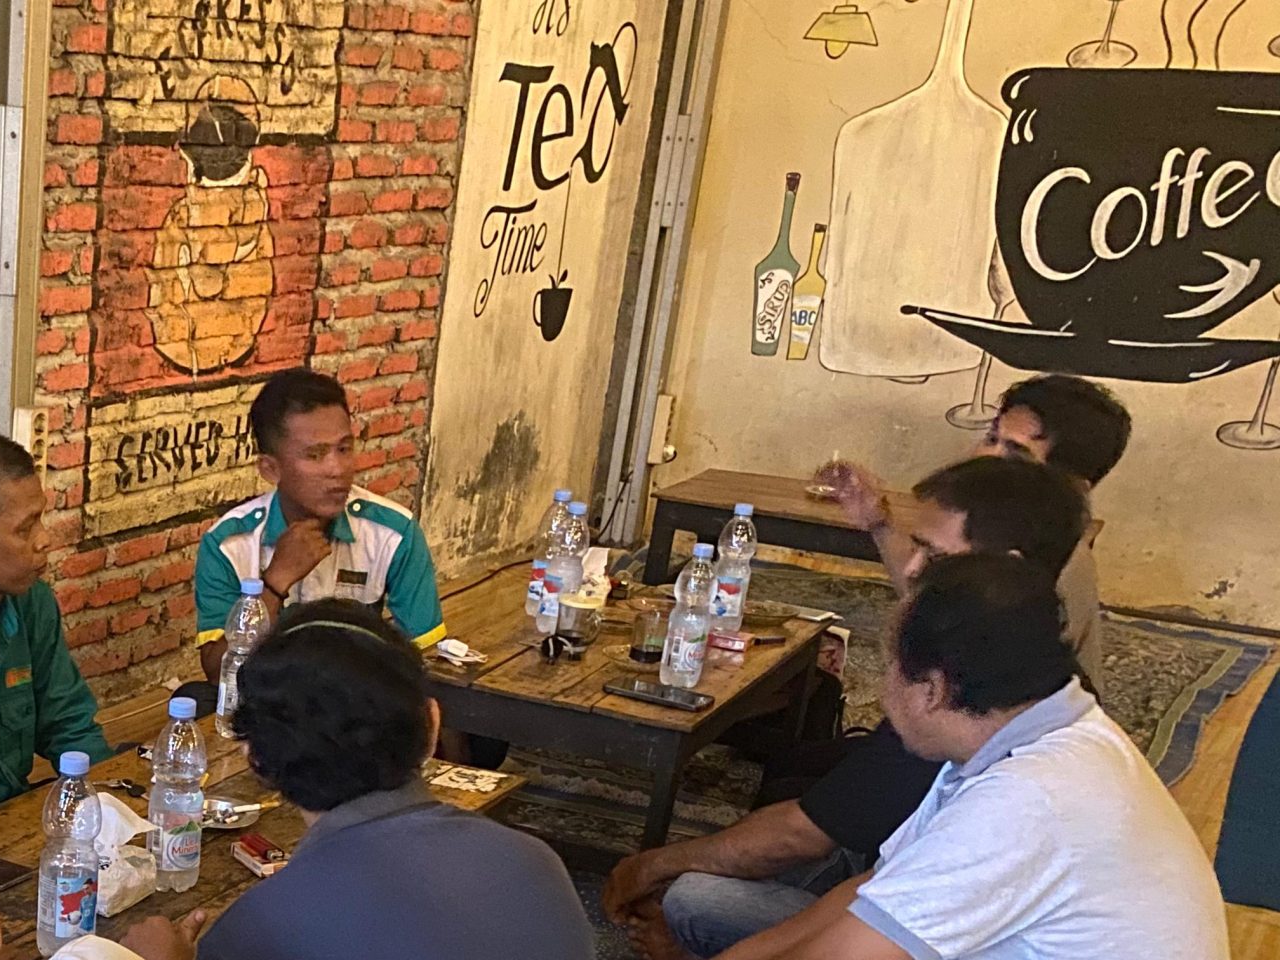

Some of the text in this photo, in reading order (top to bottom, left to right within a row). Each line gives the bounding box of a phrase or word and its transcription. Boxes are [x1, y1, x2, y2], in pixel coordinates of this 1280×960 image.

[498, 21, 639, 192] Tea
[473, 198, 548, 319] Time
[1020, 146, 1280, 282] Coffe
[791, 309, 817, 327] ABC
[114, 419, 224, 489] SERVED
